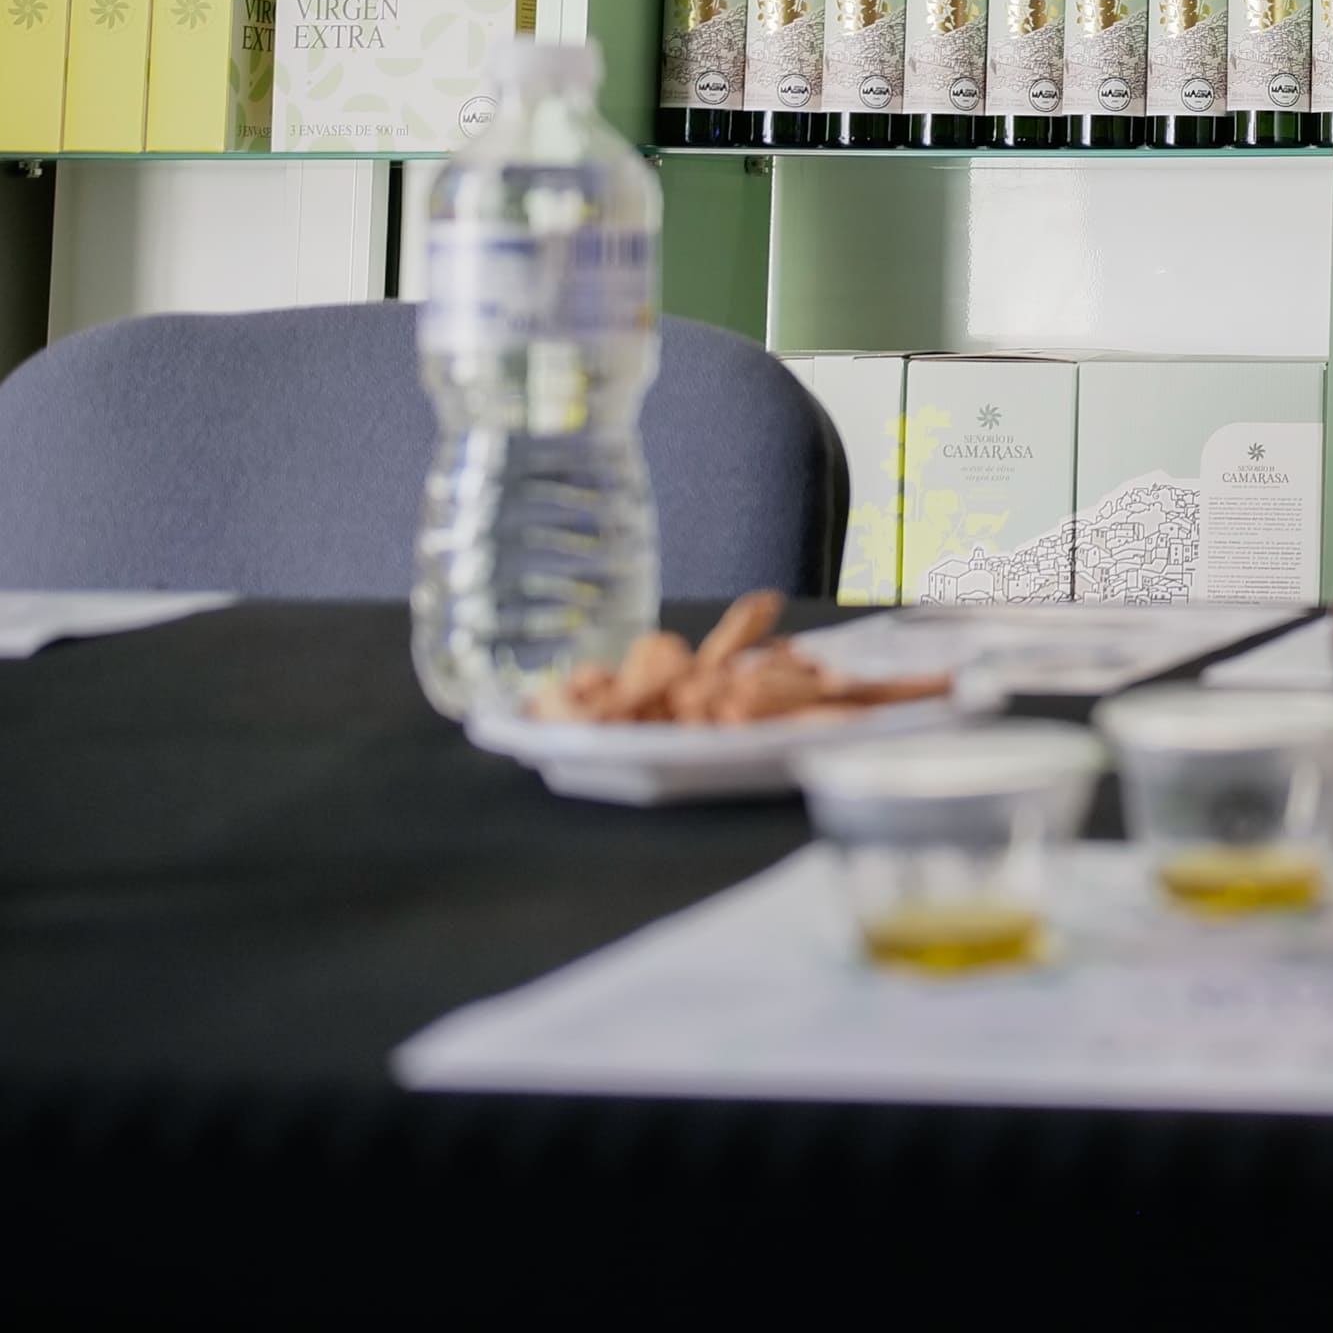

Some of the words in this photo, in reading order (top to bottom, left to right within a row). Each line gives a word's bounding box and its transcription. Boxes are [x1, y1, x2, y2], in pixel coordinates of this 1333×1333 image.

[294, 24, 385, 48] EXTRA
[238, 125, 242, 137] 3
[290, 124, 296, 136] 3
[299, 124, 352, 136] ENVASES
[355, 124, 371, 136] DE
[375, 124, 393, 136] 500
[395, 123, 409, 136] ml
[943, 444, 1034, 461] CAMARASA
[1221, 472, 1290, 485] CAMARASA
